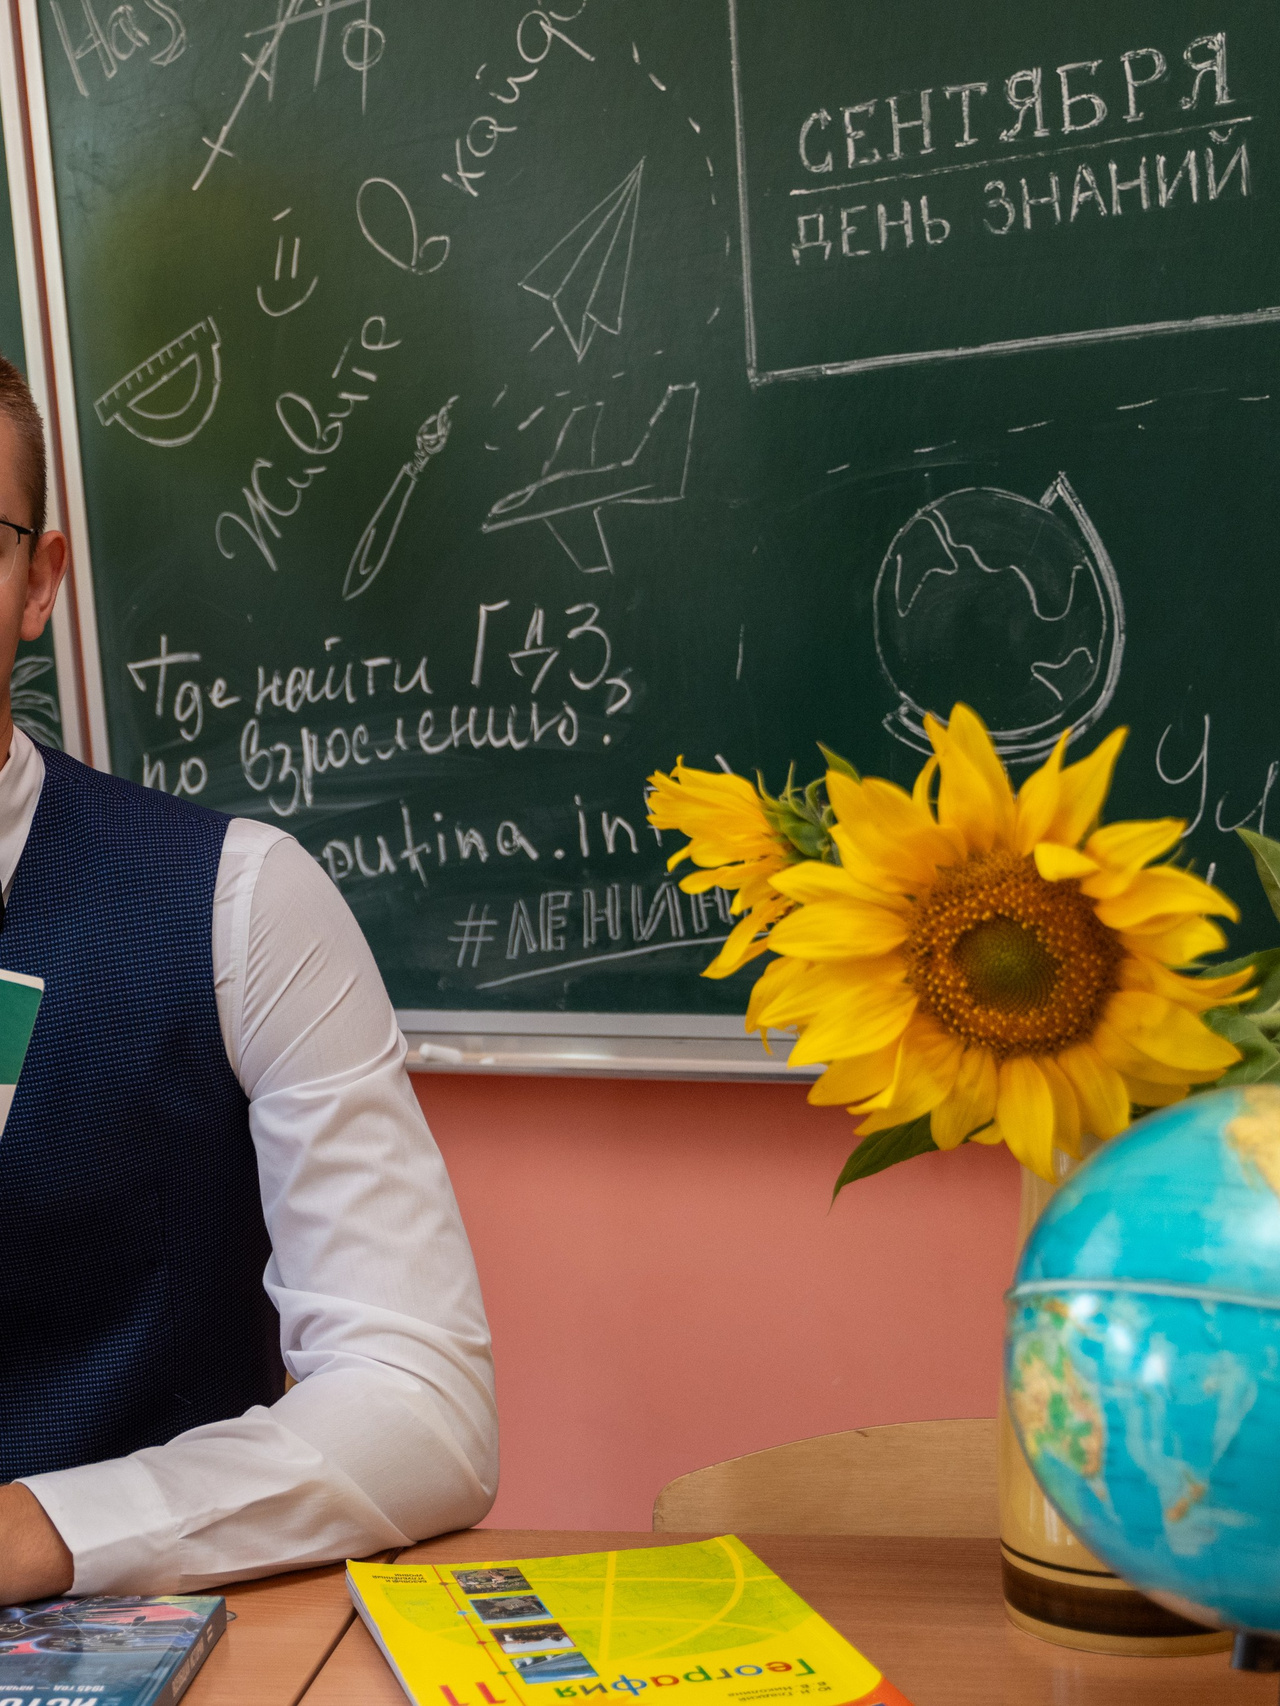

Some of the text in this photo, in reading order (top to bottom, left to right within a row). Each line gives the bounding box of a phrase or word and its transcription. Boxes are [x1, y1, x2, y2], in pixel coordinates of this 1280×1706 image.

[798, 32, 1237, 174] СЕНТЯБРЯ
[790, 125, 1252, 266] ДЕНЬ ЗНАНИЙ
[214, 315, 403, 572] Живите
[127, 600, 614, 741] Где найти ГДЗ
[142, 752, 209, 796] по
[447, 880, 738, 968] #ЛЕНИН
[438, 1681, 508, 1706] 11
[554, 1656, 817, 1699] География
